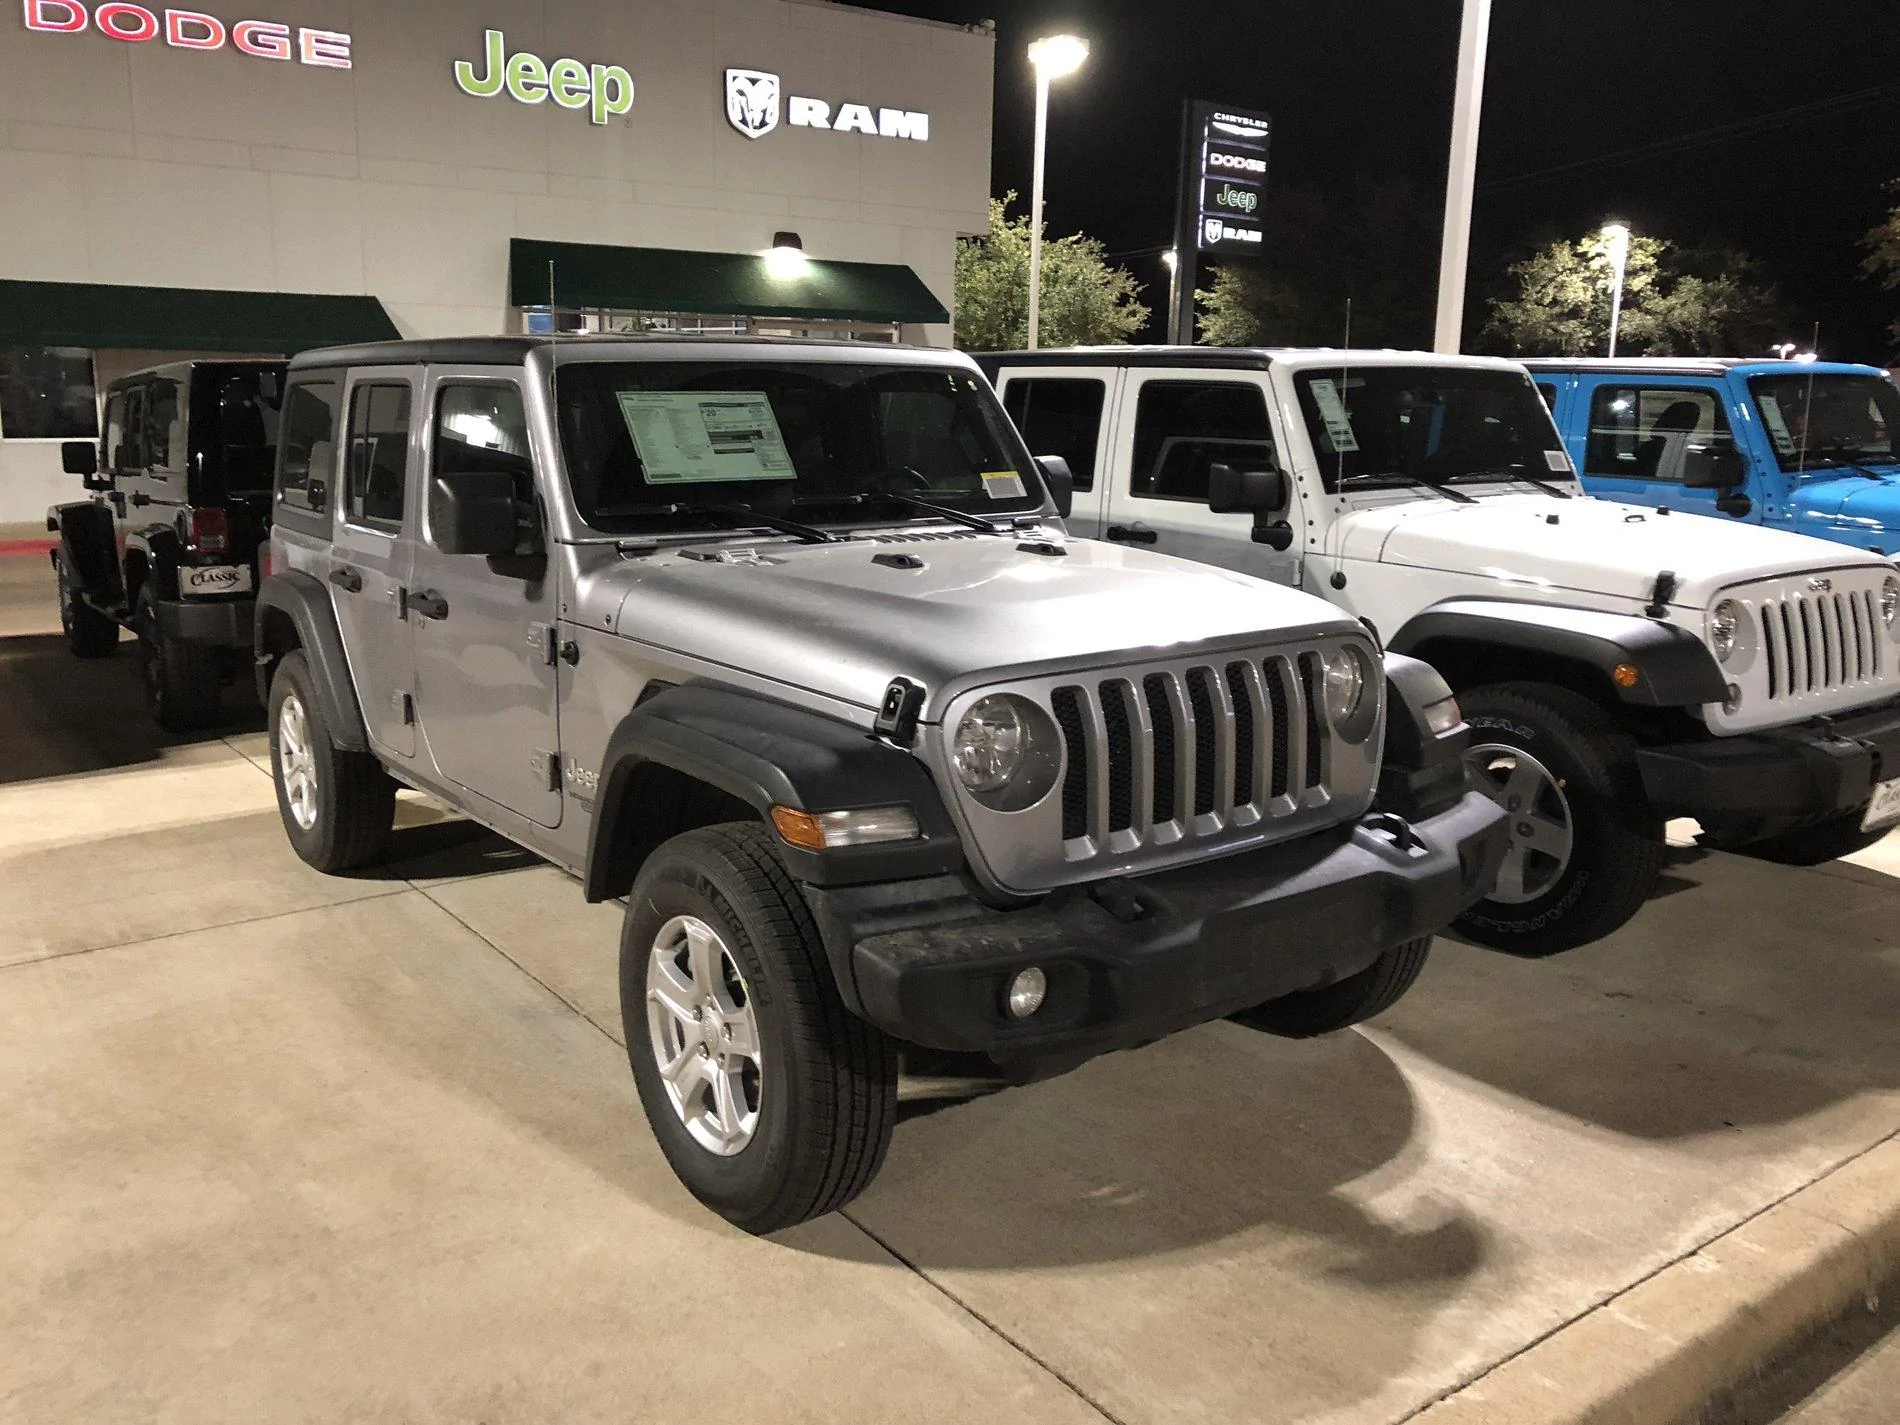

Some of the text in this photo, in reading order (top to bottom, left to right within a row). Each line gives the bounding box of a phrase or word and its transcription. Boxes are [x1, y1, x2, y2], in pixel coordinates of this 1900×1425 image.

[23, 0, 353, 69] DODGE
[454, 29, 635, 125] Jeep
[788, 96, 930, 142] RAM
[1213, 112, 1268, 129] CHRYSLER
[1210, 153, 1267, 173] DODGE
[1216, 183, 1258, 213] Jeep
[1222, 227, 1263, 243] RAM
[191, 572, 240, 587] CLASSIC
